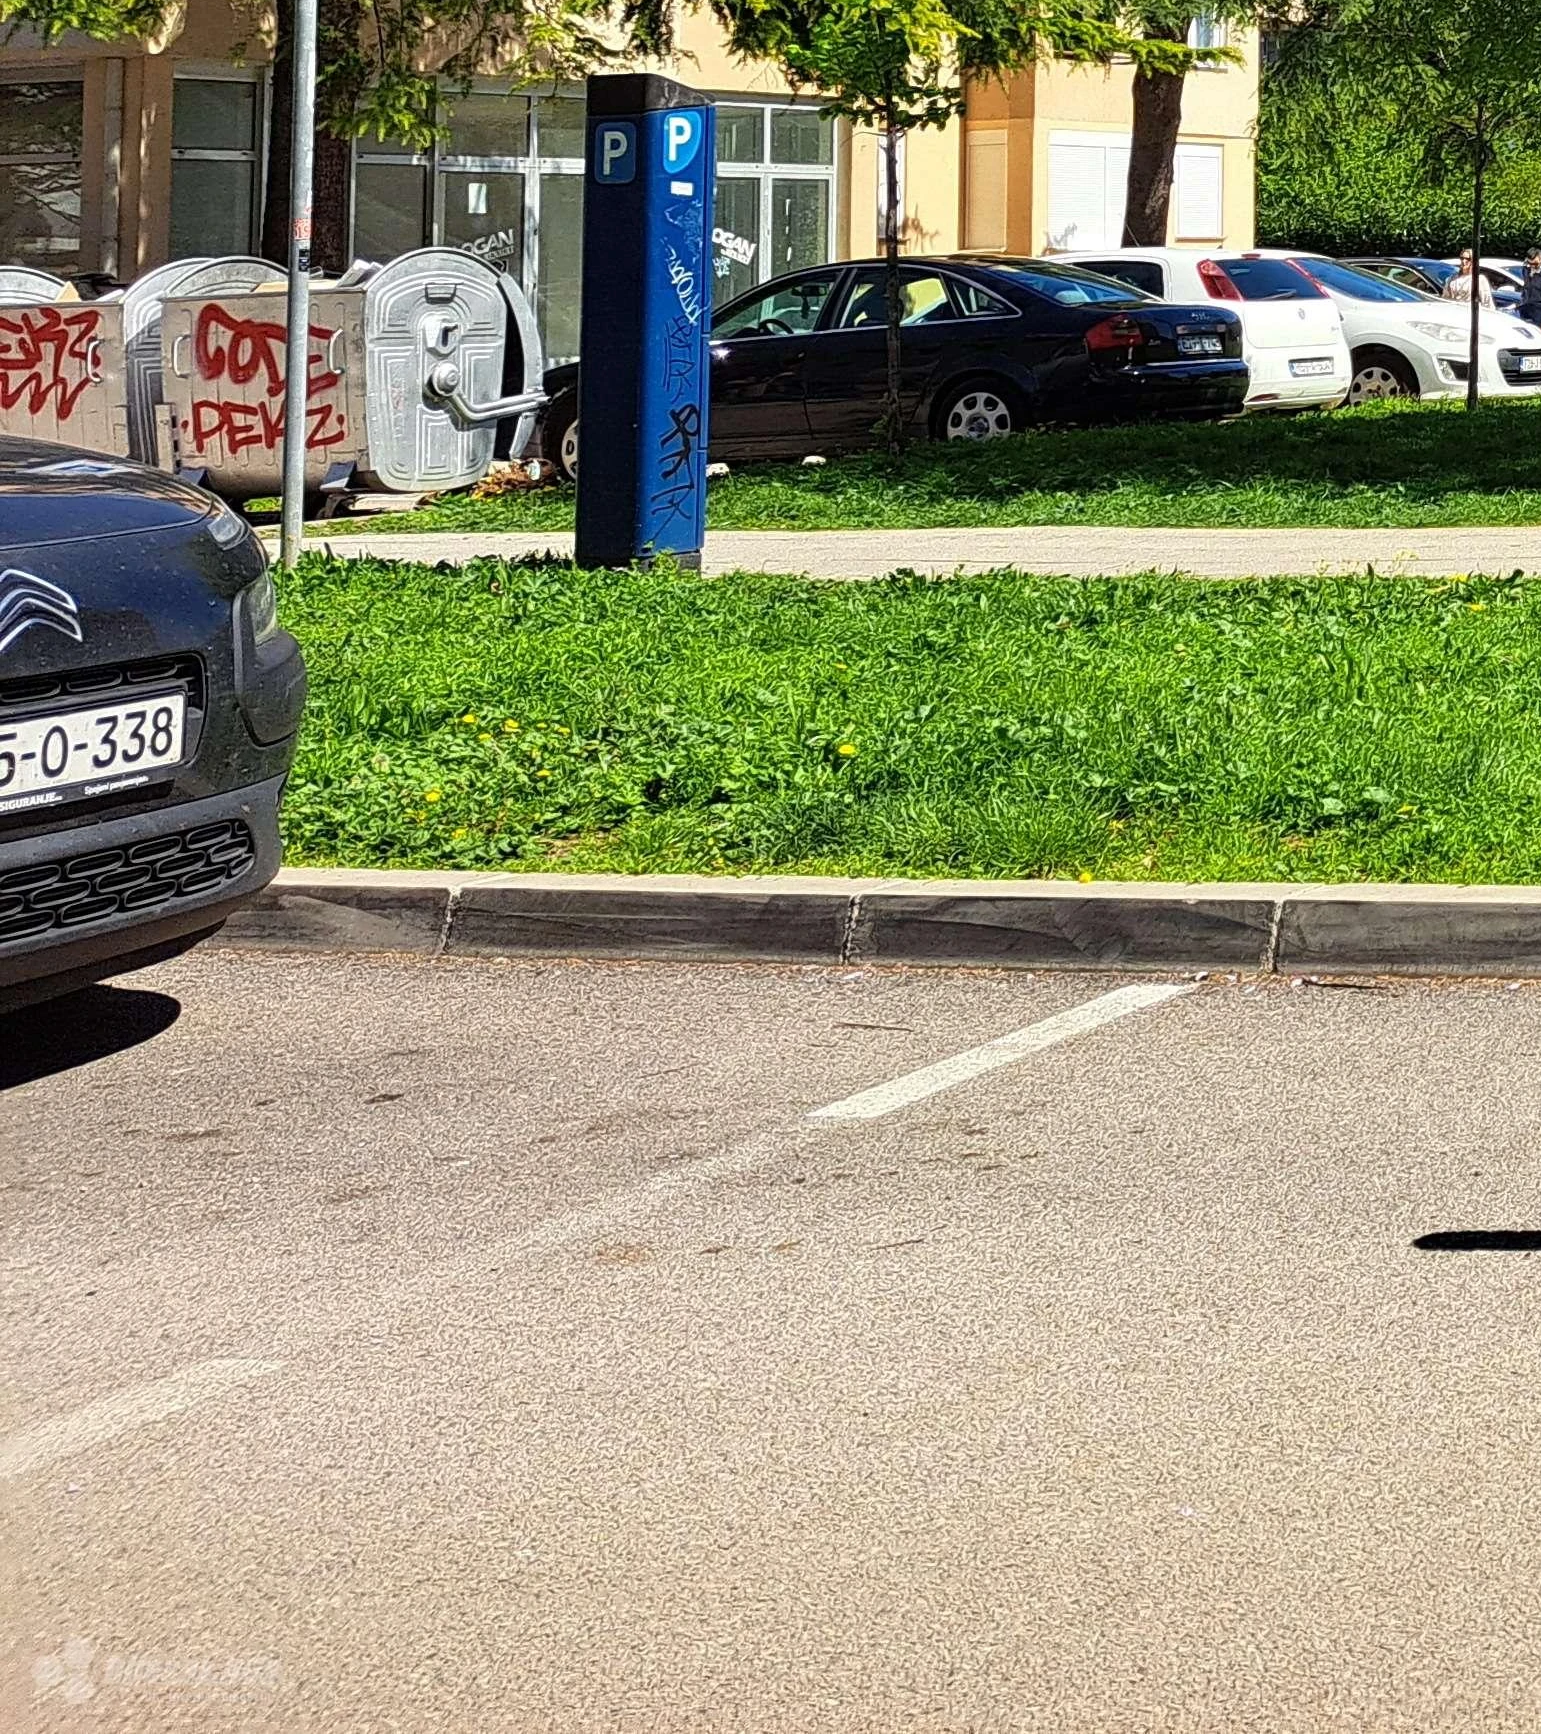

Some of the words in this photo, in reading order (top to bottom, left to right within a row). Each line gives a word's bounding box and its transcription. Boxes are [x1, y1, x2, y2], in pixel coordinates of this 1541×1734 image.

[602, 130, 627, 175] P
[668, 116, 692, 162] P
[461, 228, 514, 255] OGAN
[712, 227, 757, 261] OGAN
